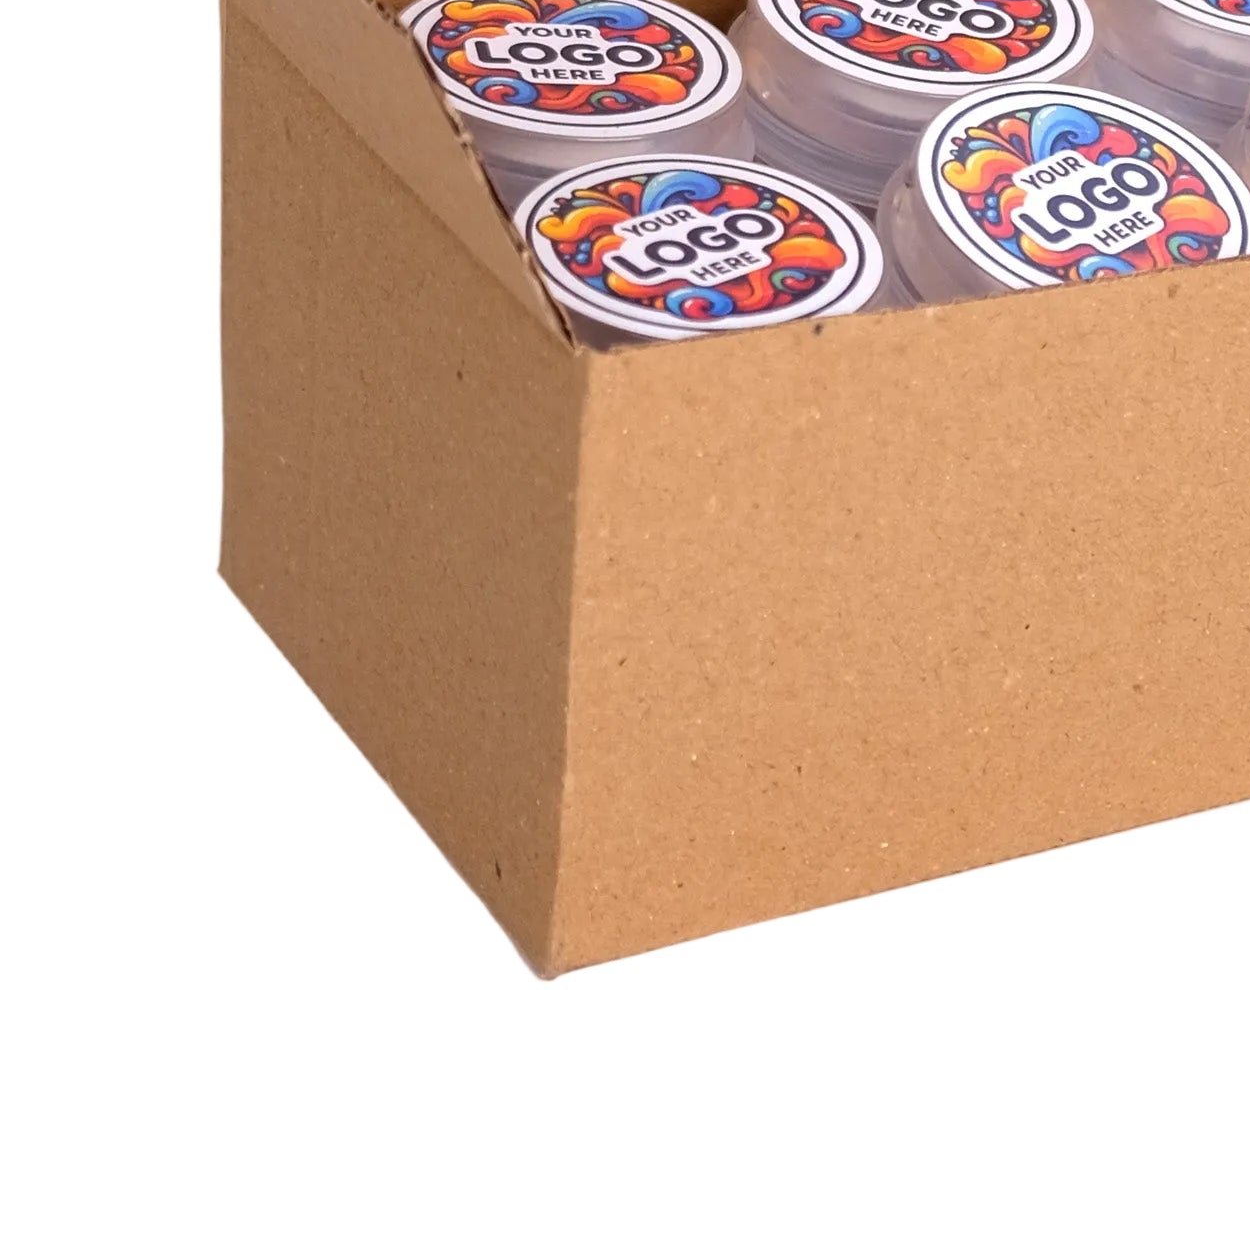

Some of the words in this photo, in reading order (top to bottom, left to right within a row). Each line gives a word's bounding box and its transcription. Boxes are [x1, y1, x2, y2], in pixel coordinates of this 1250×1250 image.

[514, 26, 593, 39] YOUR
[870, 8, 943, 37] HERE
[475, 41, 655, 68] LOGO
[531, 68, 605, 81] HERE
[1020, 155, 1086, 190] YOUR
[1018, 162, 1160, 243] LOGO
[621, 208, 697, 237] YOUR
[1094, 211, 1155, 248] HERE
[611, 213, 775, 279] LOGO
[691, 250, 761, 280] HERE
